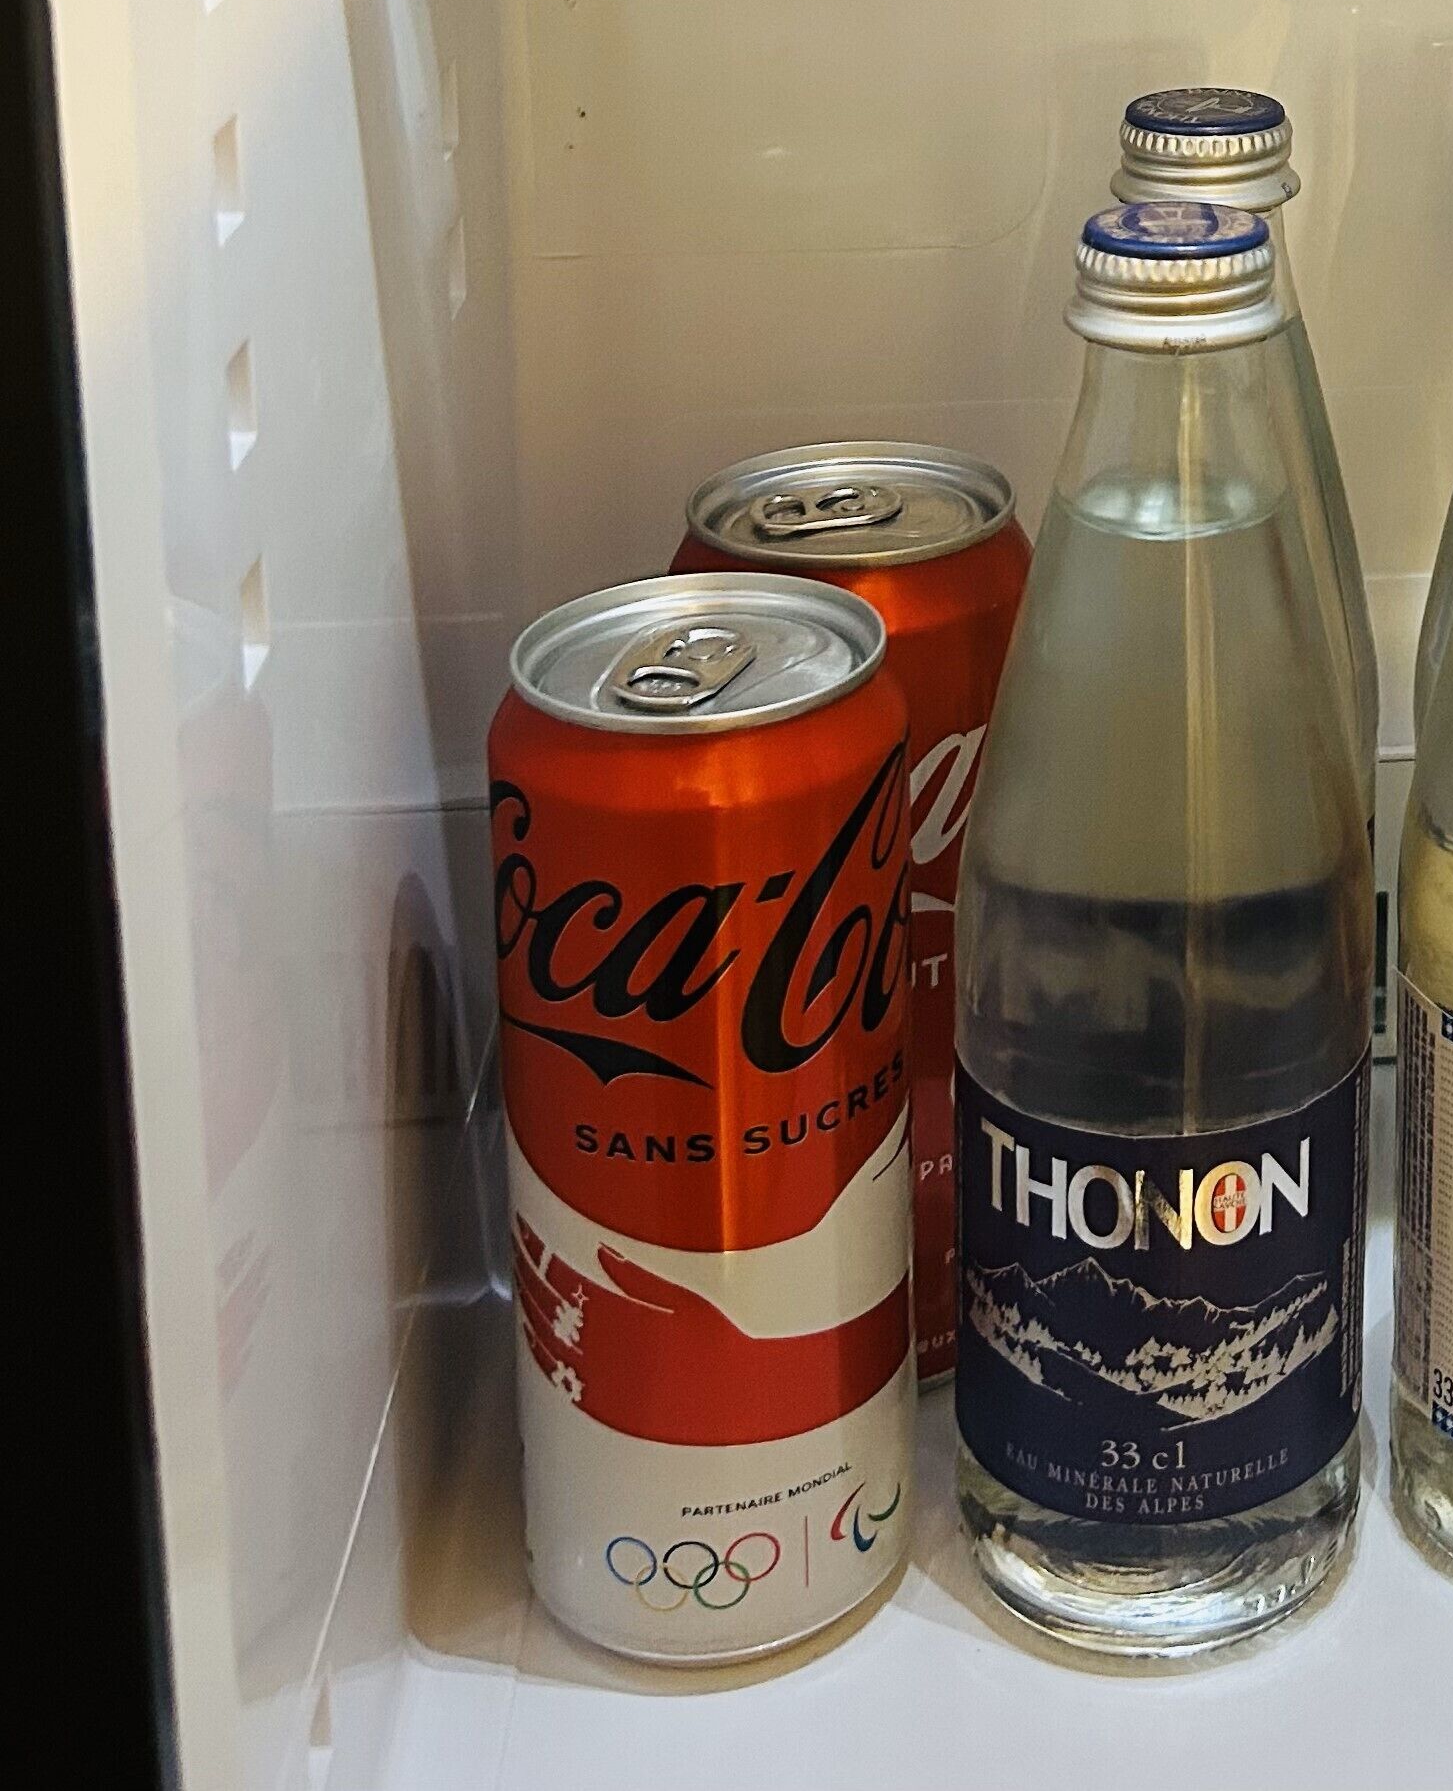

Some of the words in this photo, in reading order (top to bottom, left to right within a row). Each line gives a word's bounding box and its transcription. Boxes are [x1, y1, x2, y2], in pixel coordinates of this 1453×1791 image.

[575, 1124, 716, 1163] SANS
[981, 1116, 1310, 1251] THONON
[1006, 1442, 1037, 1470] EAU
[1047, 1463, 1157, 1494] MINÉRALE
[1171, 1447, 1288, 1493] NATURELLE
[1101, 1440, 1140, 1469] 33
[682, 1490, 783, 1517] PARTENAIRE
[788, 1462, 852, 1498] MONDIAL
[1086, 1494, 1125, 1513] DES
[1139, 1495, 1205, 1515] ALPES
